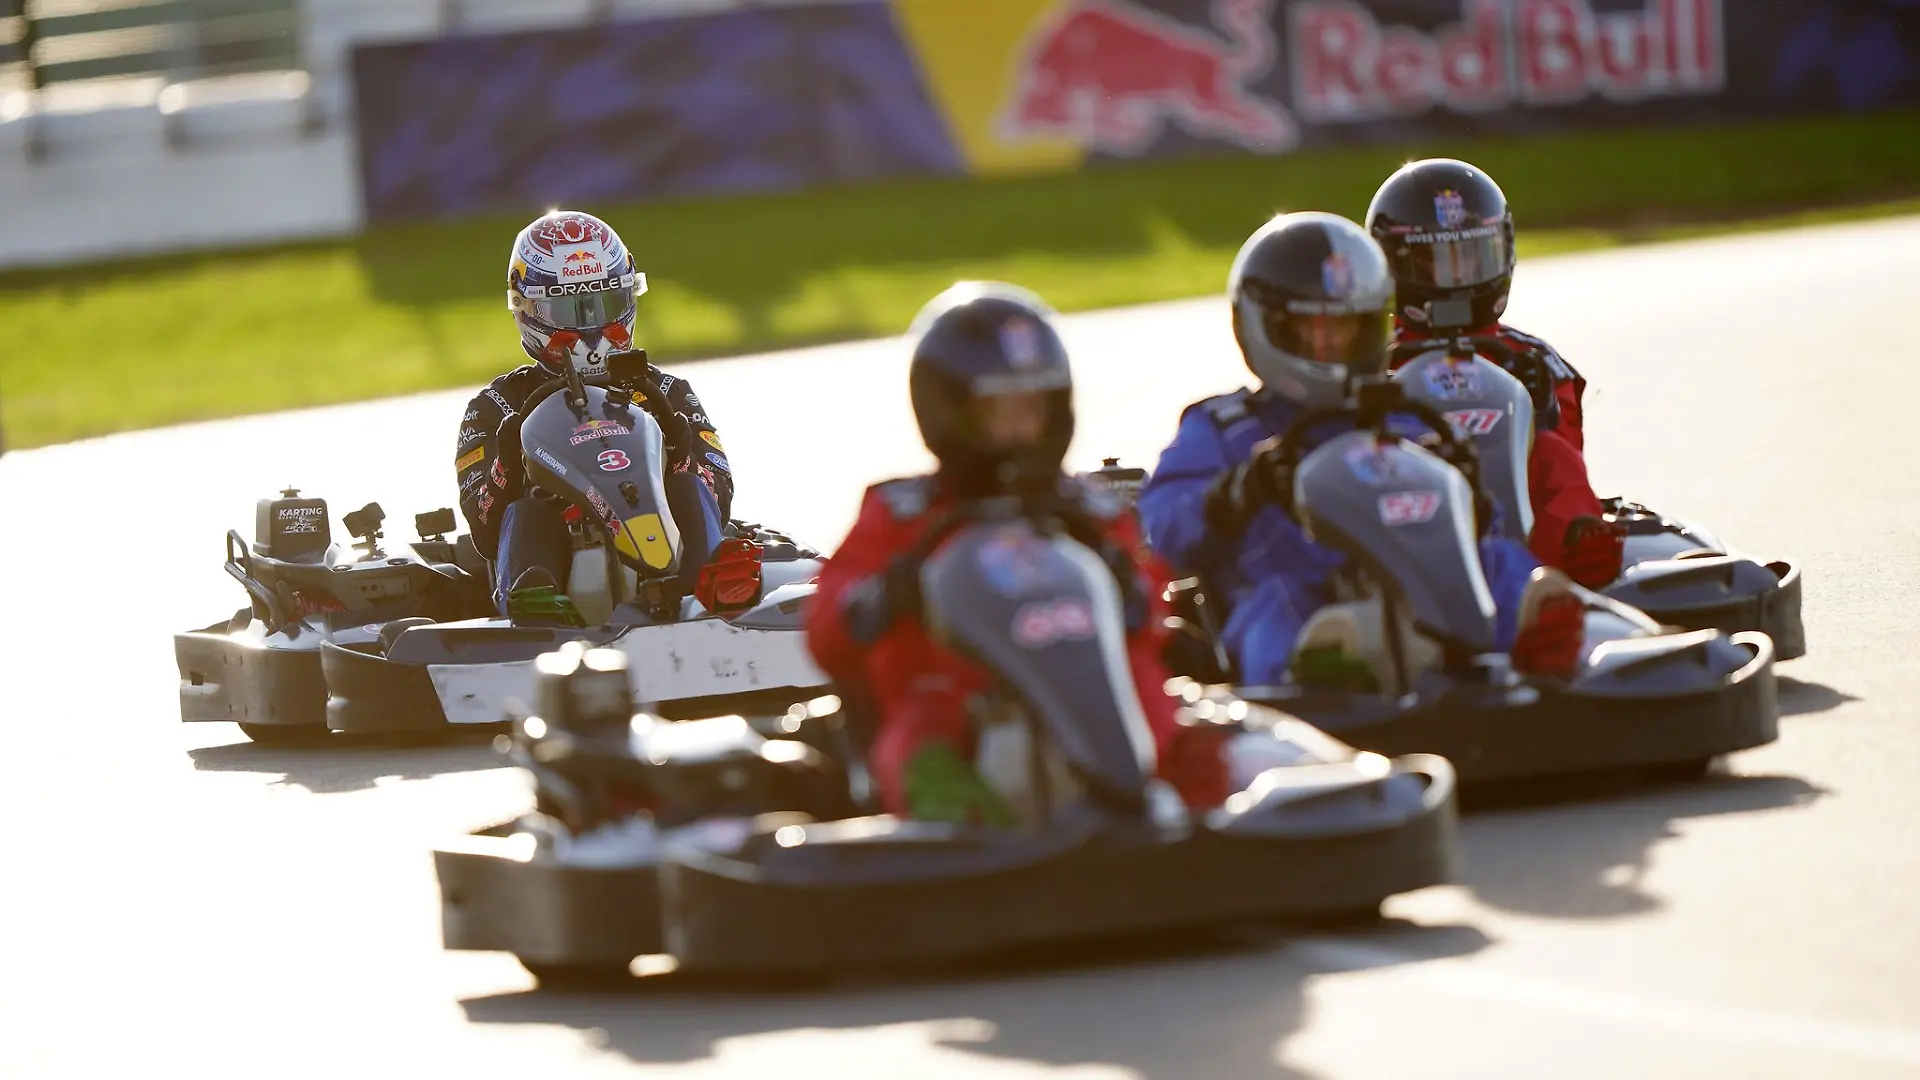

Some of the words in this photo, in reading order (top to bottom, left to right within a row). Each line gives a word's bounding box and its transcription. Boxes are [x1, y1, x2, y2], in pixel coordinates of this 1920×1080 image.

[1290, 0, 1504, 118] Red
[1514, 0, 1726, 105] Bull
[1435, 231, 1460, 241] YOU
[562, 264, 582, 277] Red
[583, 262, 603, 275] Bull
[548, 277, 620, 296] ORACLE
[569, 428, 601, 446] Red
[600, 426, 630, 437] Bull
[597, 449, 631, 471] 3
[279, 507, 322, 516] KARTING
